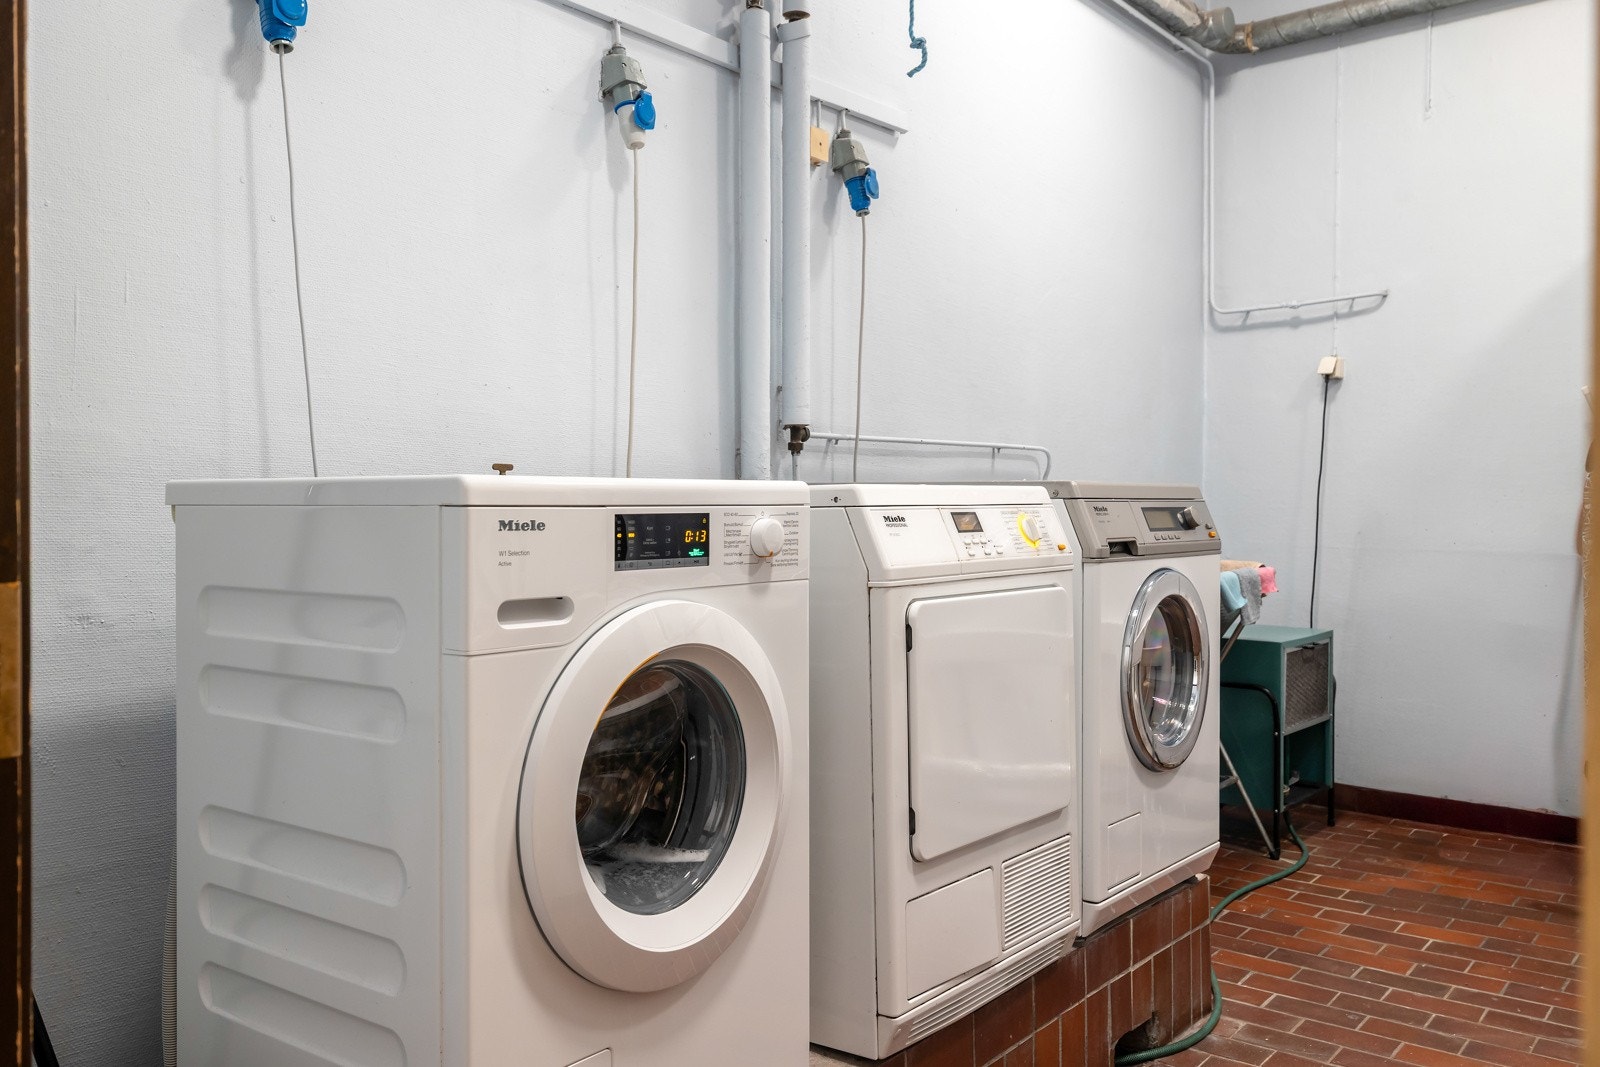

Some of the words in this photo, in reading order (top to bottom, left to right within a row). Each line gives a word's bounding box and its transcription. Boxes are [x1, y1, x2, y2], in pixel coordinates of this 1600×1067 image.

[498, 519, 546, 531] Miele
[882, 515, 906, 523] Miele
[684, 530, 707, 543] 0:13
